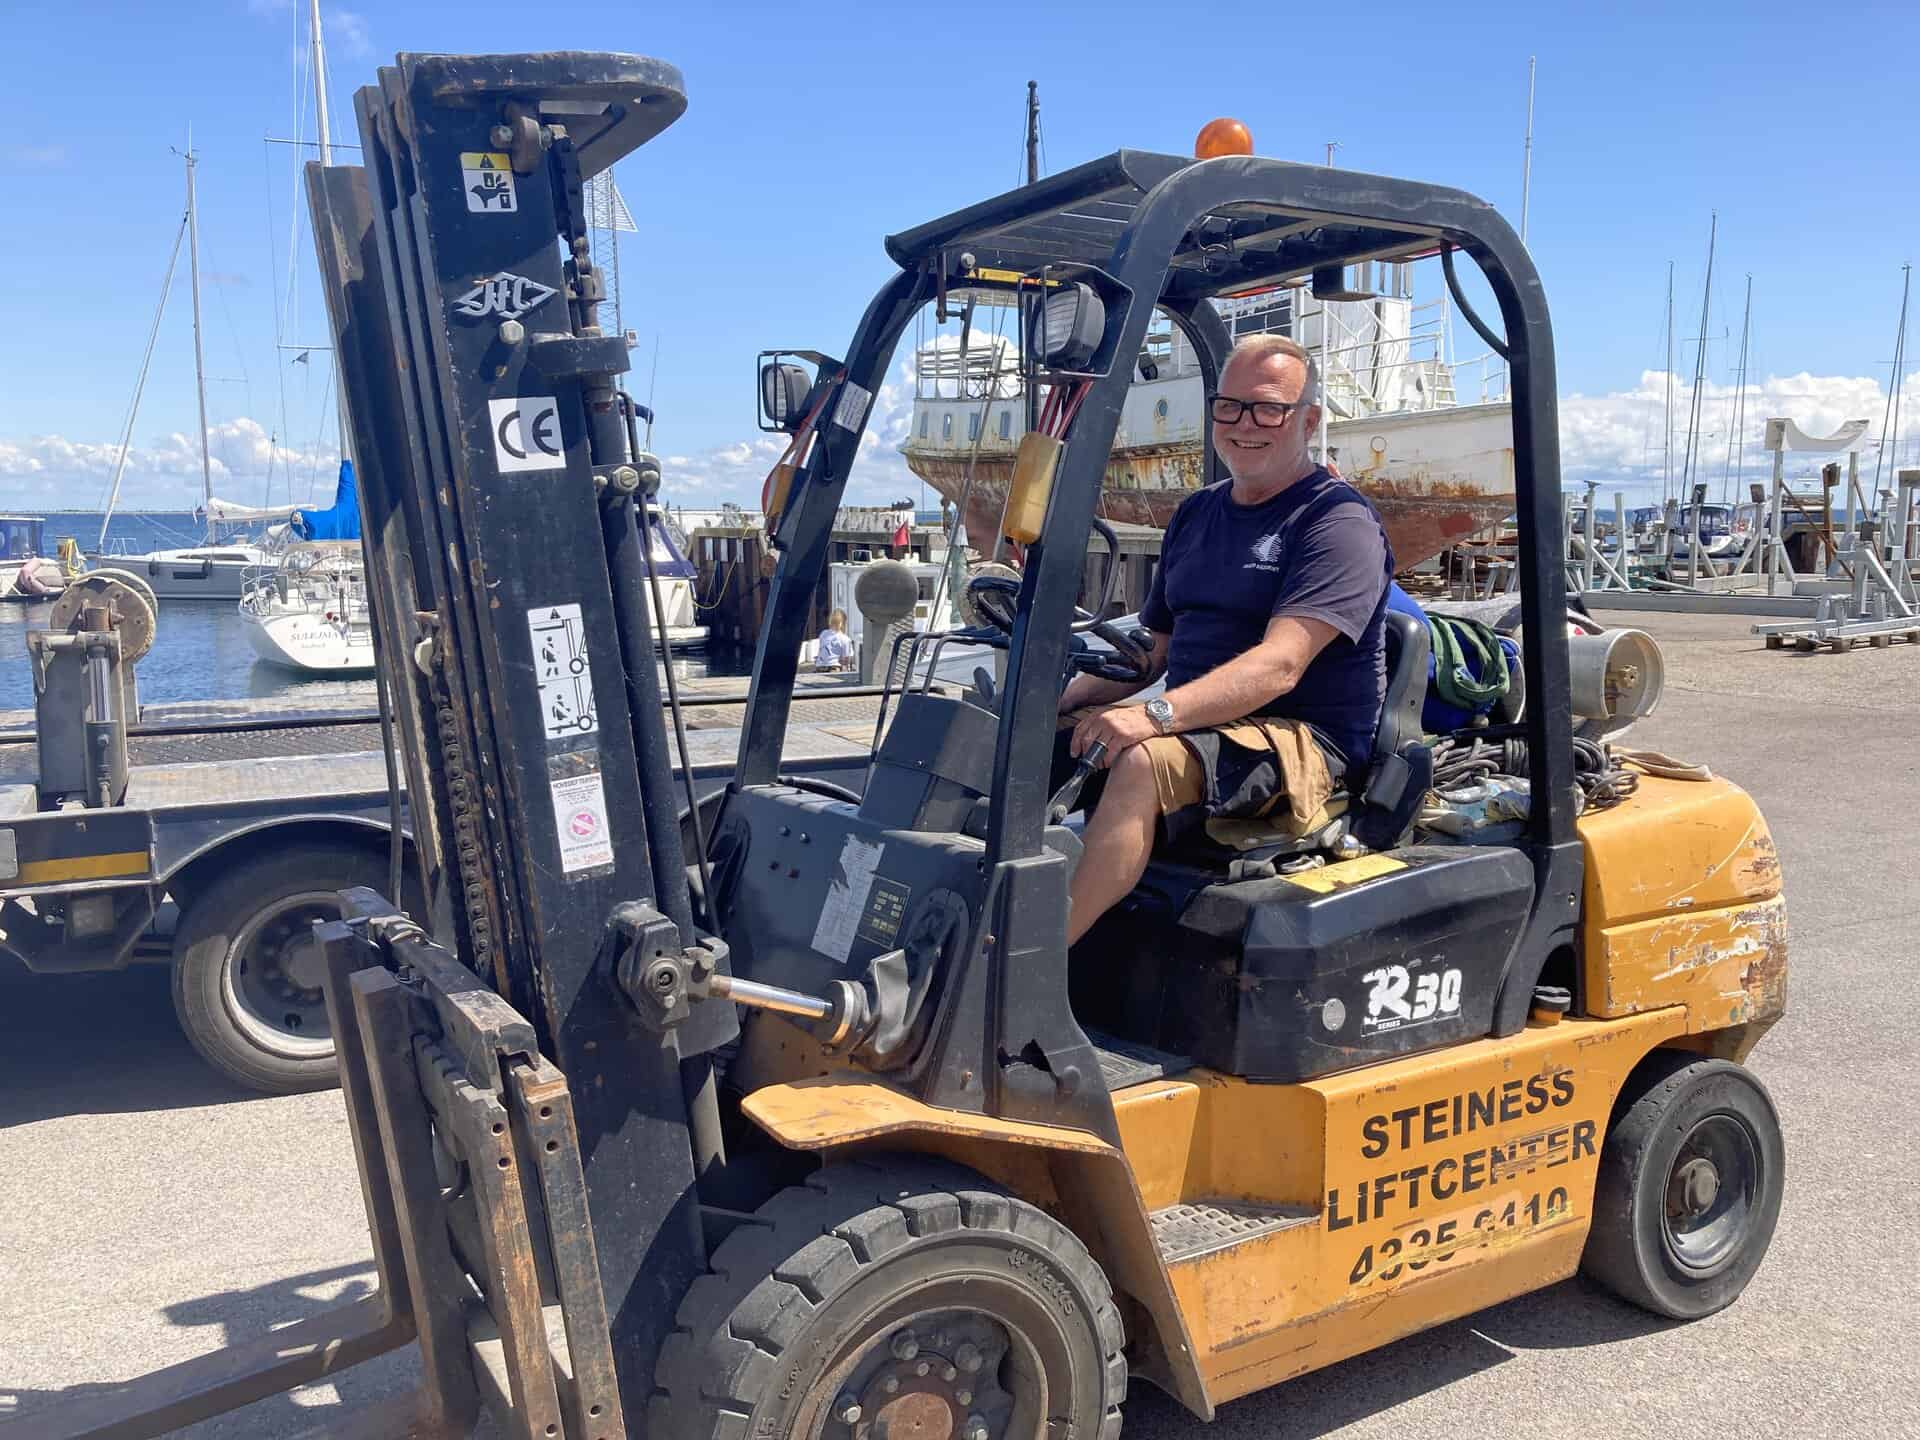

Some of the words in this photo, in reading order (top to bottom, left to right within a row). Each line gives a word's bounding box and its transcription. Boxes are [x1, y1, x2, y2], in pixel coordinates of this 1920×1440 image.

[498, 408, 560, 459] CE
[1361, 1069, 1575, 1159] STEINESS
[1327, 1120, 1597, 1232] LIFTCENTER
